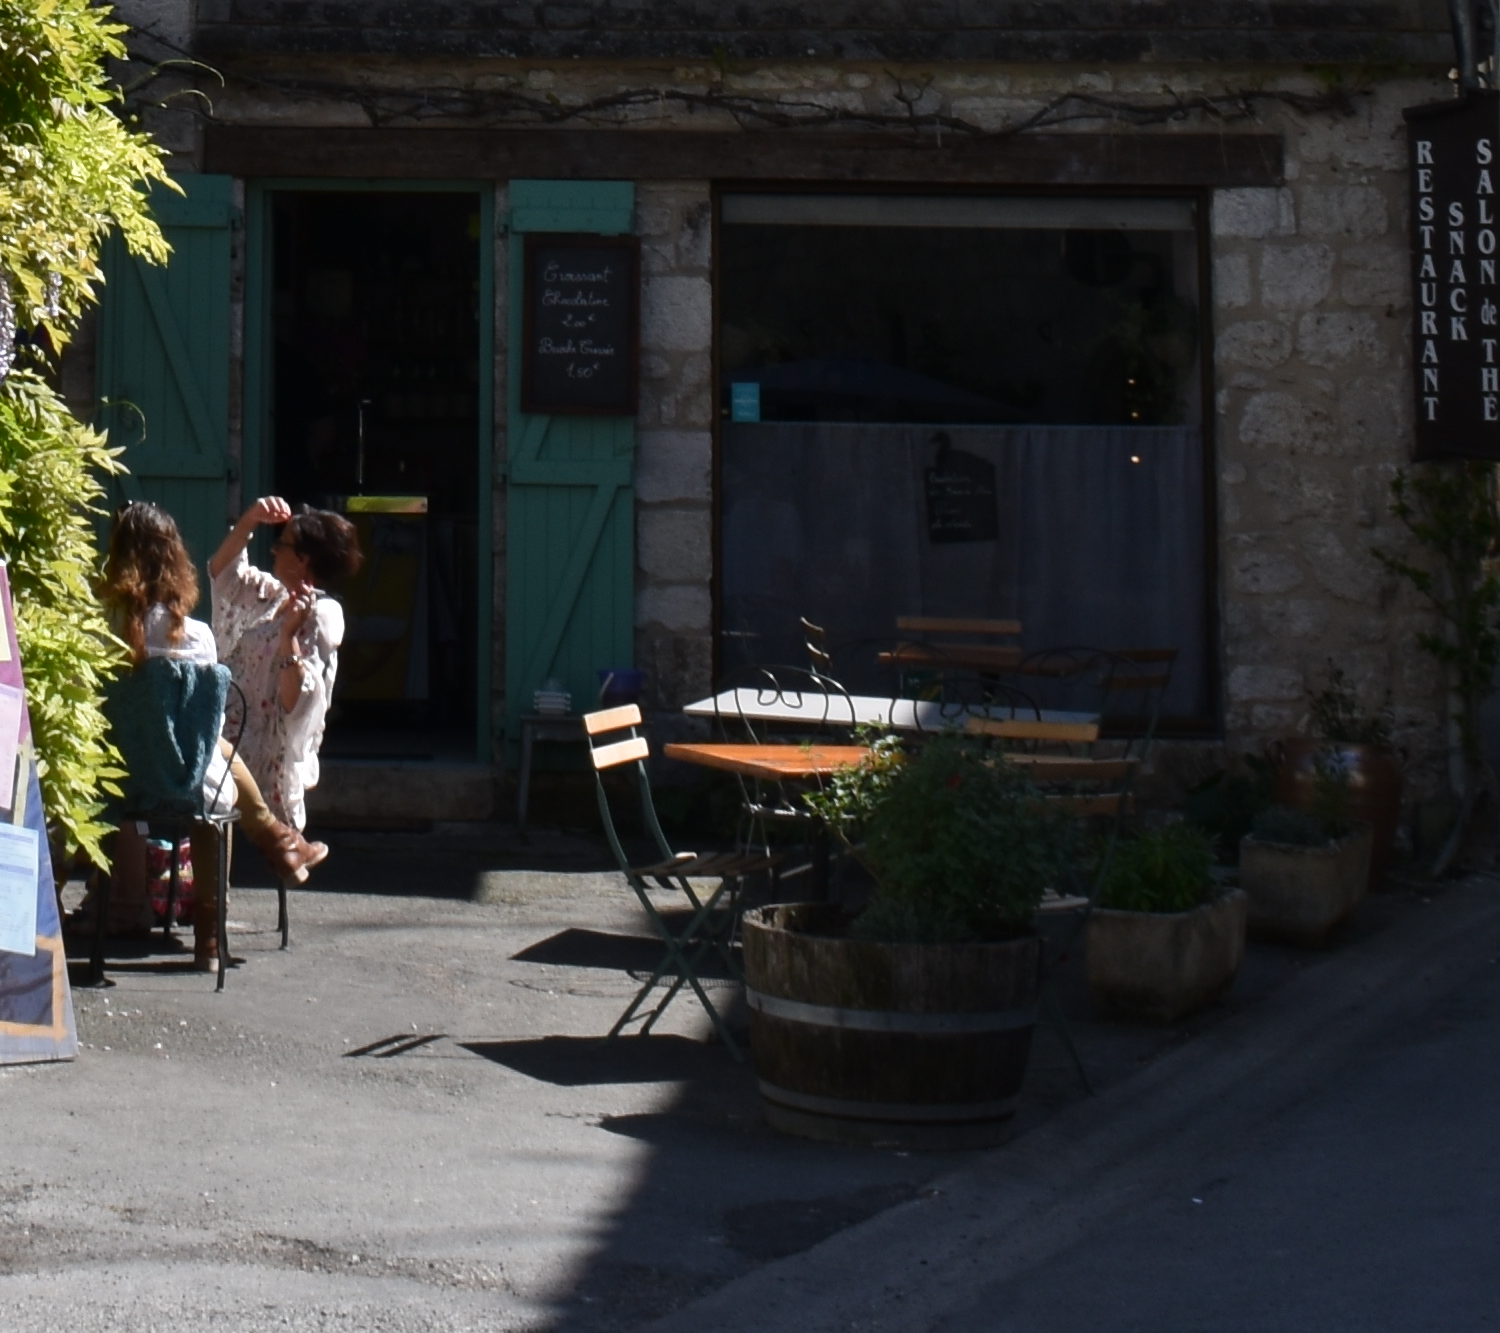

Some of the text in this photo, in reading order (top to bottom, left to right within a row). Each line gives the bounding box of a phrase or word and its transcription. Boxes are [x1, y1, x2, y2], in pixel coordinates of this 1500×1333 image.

[1475, 138, 1497, 285] SALON
[542, 288, 611, 307] Chocolatine
[543, 259, 613, 284] Croissant
[1416, 140, 1440, 421] RESTAURANT
[1448, 201, 1468, 341] SNACK
[1481, 297, 1497, 325] de
